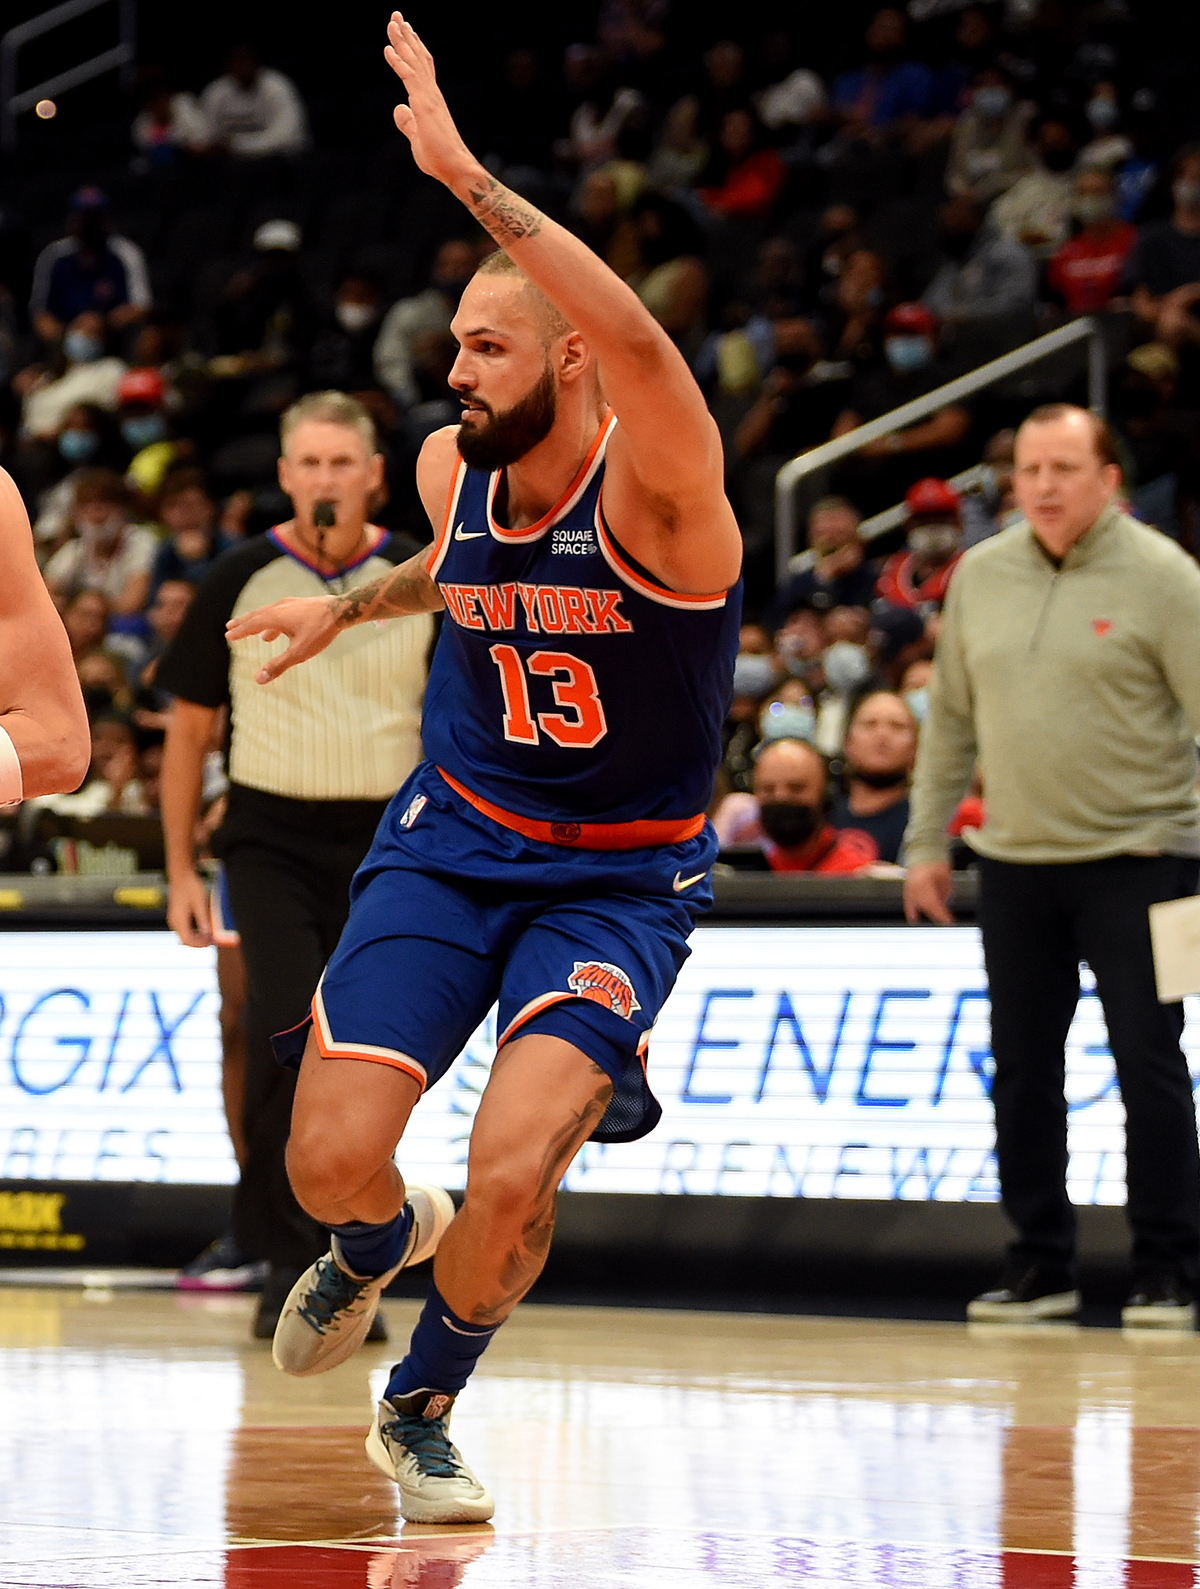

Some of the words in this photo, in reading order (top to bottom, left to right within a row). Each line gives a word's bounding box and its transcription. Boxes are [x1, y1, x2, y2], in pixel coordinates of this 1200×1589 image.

[551, 543, 588, 555] SPACE
[438, 581, 516, 631] NEW
[517, 584, 634, 634] YORK
[489, 643, 608, 749] 13
[571, 964, 632, 1017] KNICKS
